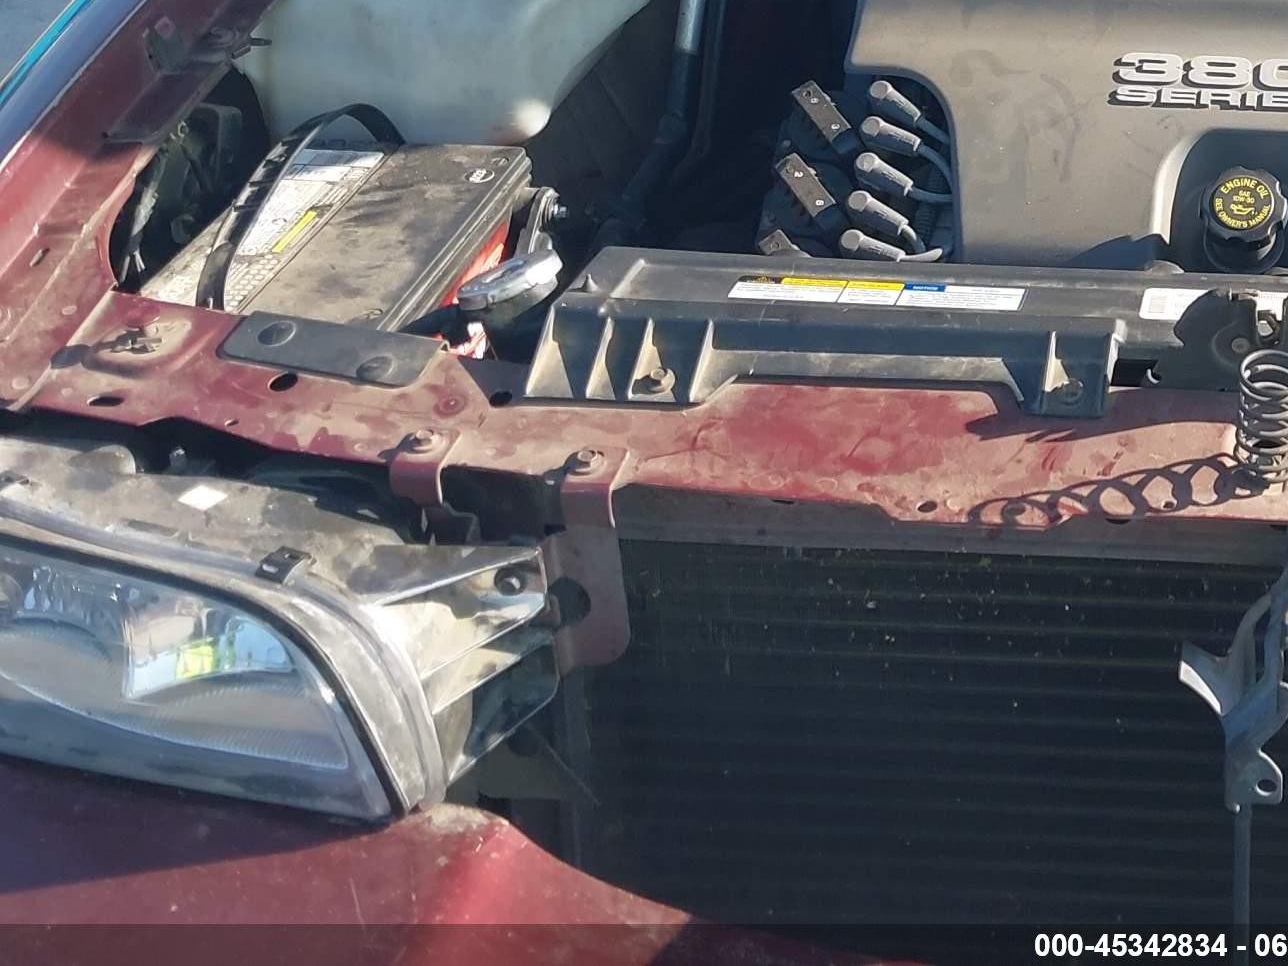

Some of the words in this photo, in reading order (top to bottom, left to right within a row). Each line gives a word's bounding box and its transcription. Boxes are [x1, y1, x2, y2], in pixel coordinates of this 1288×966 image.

[1220, 178, 1258, 194] ENGINE
[1256, 185, 1270, 199] OIL
[1215, 197, 1223, 212] SEE
[1218, 211, 1248, 229] OWNER'S
[1248, 204, 1271, 227] MANUAL
